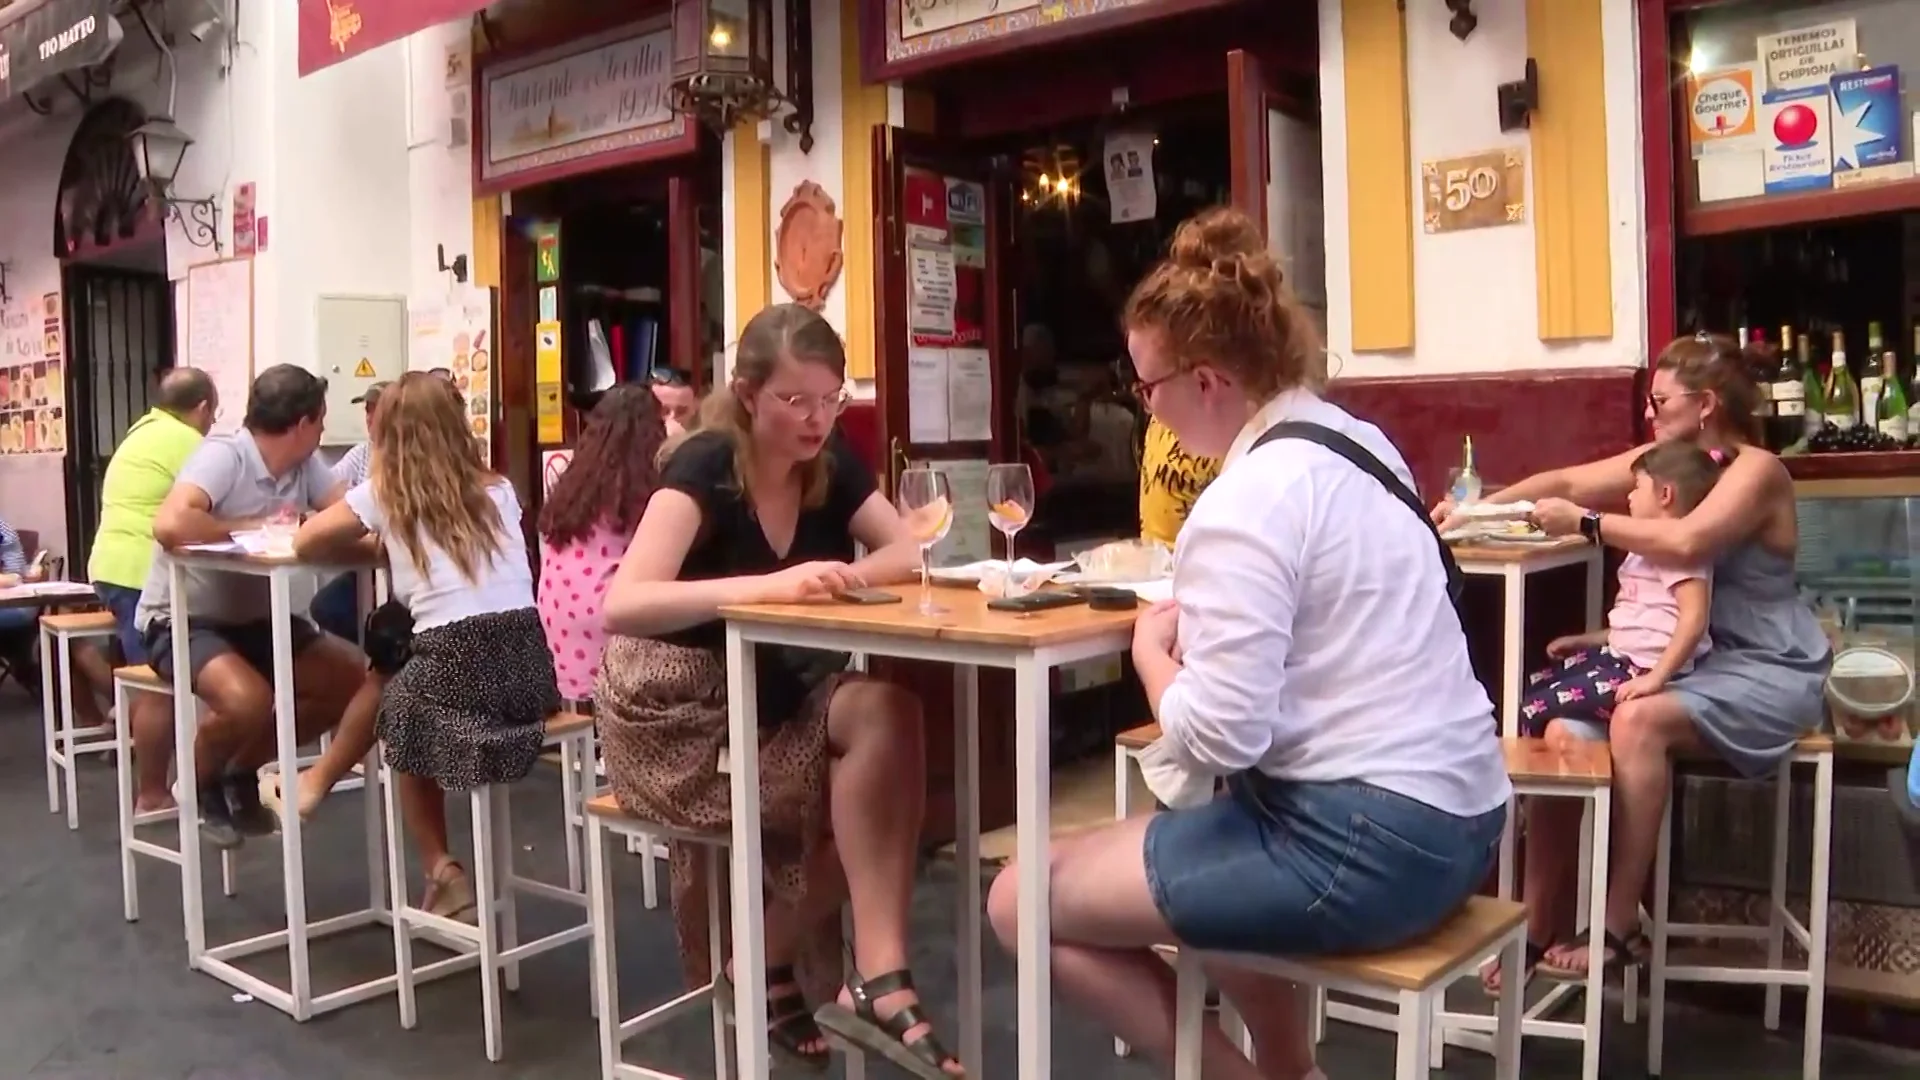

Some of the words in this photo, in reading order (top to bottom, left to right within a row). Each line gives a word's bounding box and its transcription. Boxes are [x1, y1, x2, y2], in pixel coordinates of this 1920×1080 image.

[39, 37, 57, 60] TIO
[59, 15, 95, 51] MATTO
[1776, 28, 1837, 47] TENEMOS
[1770, 39, 1844, 60] ORTIGUILLAS
[1778, 62, 1837, 81] CHIPIONA
[1698, 89, 1742, 104] Cheque
[1695, 99, 1747, 115] Gourmet
[1446, 167, 1498, 211] 50
